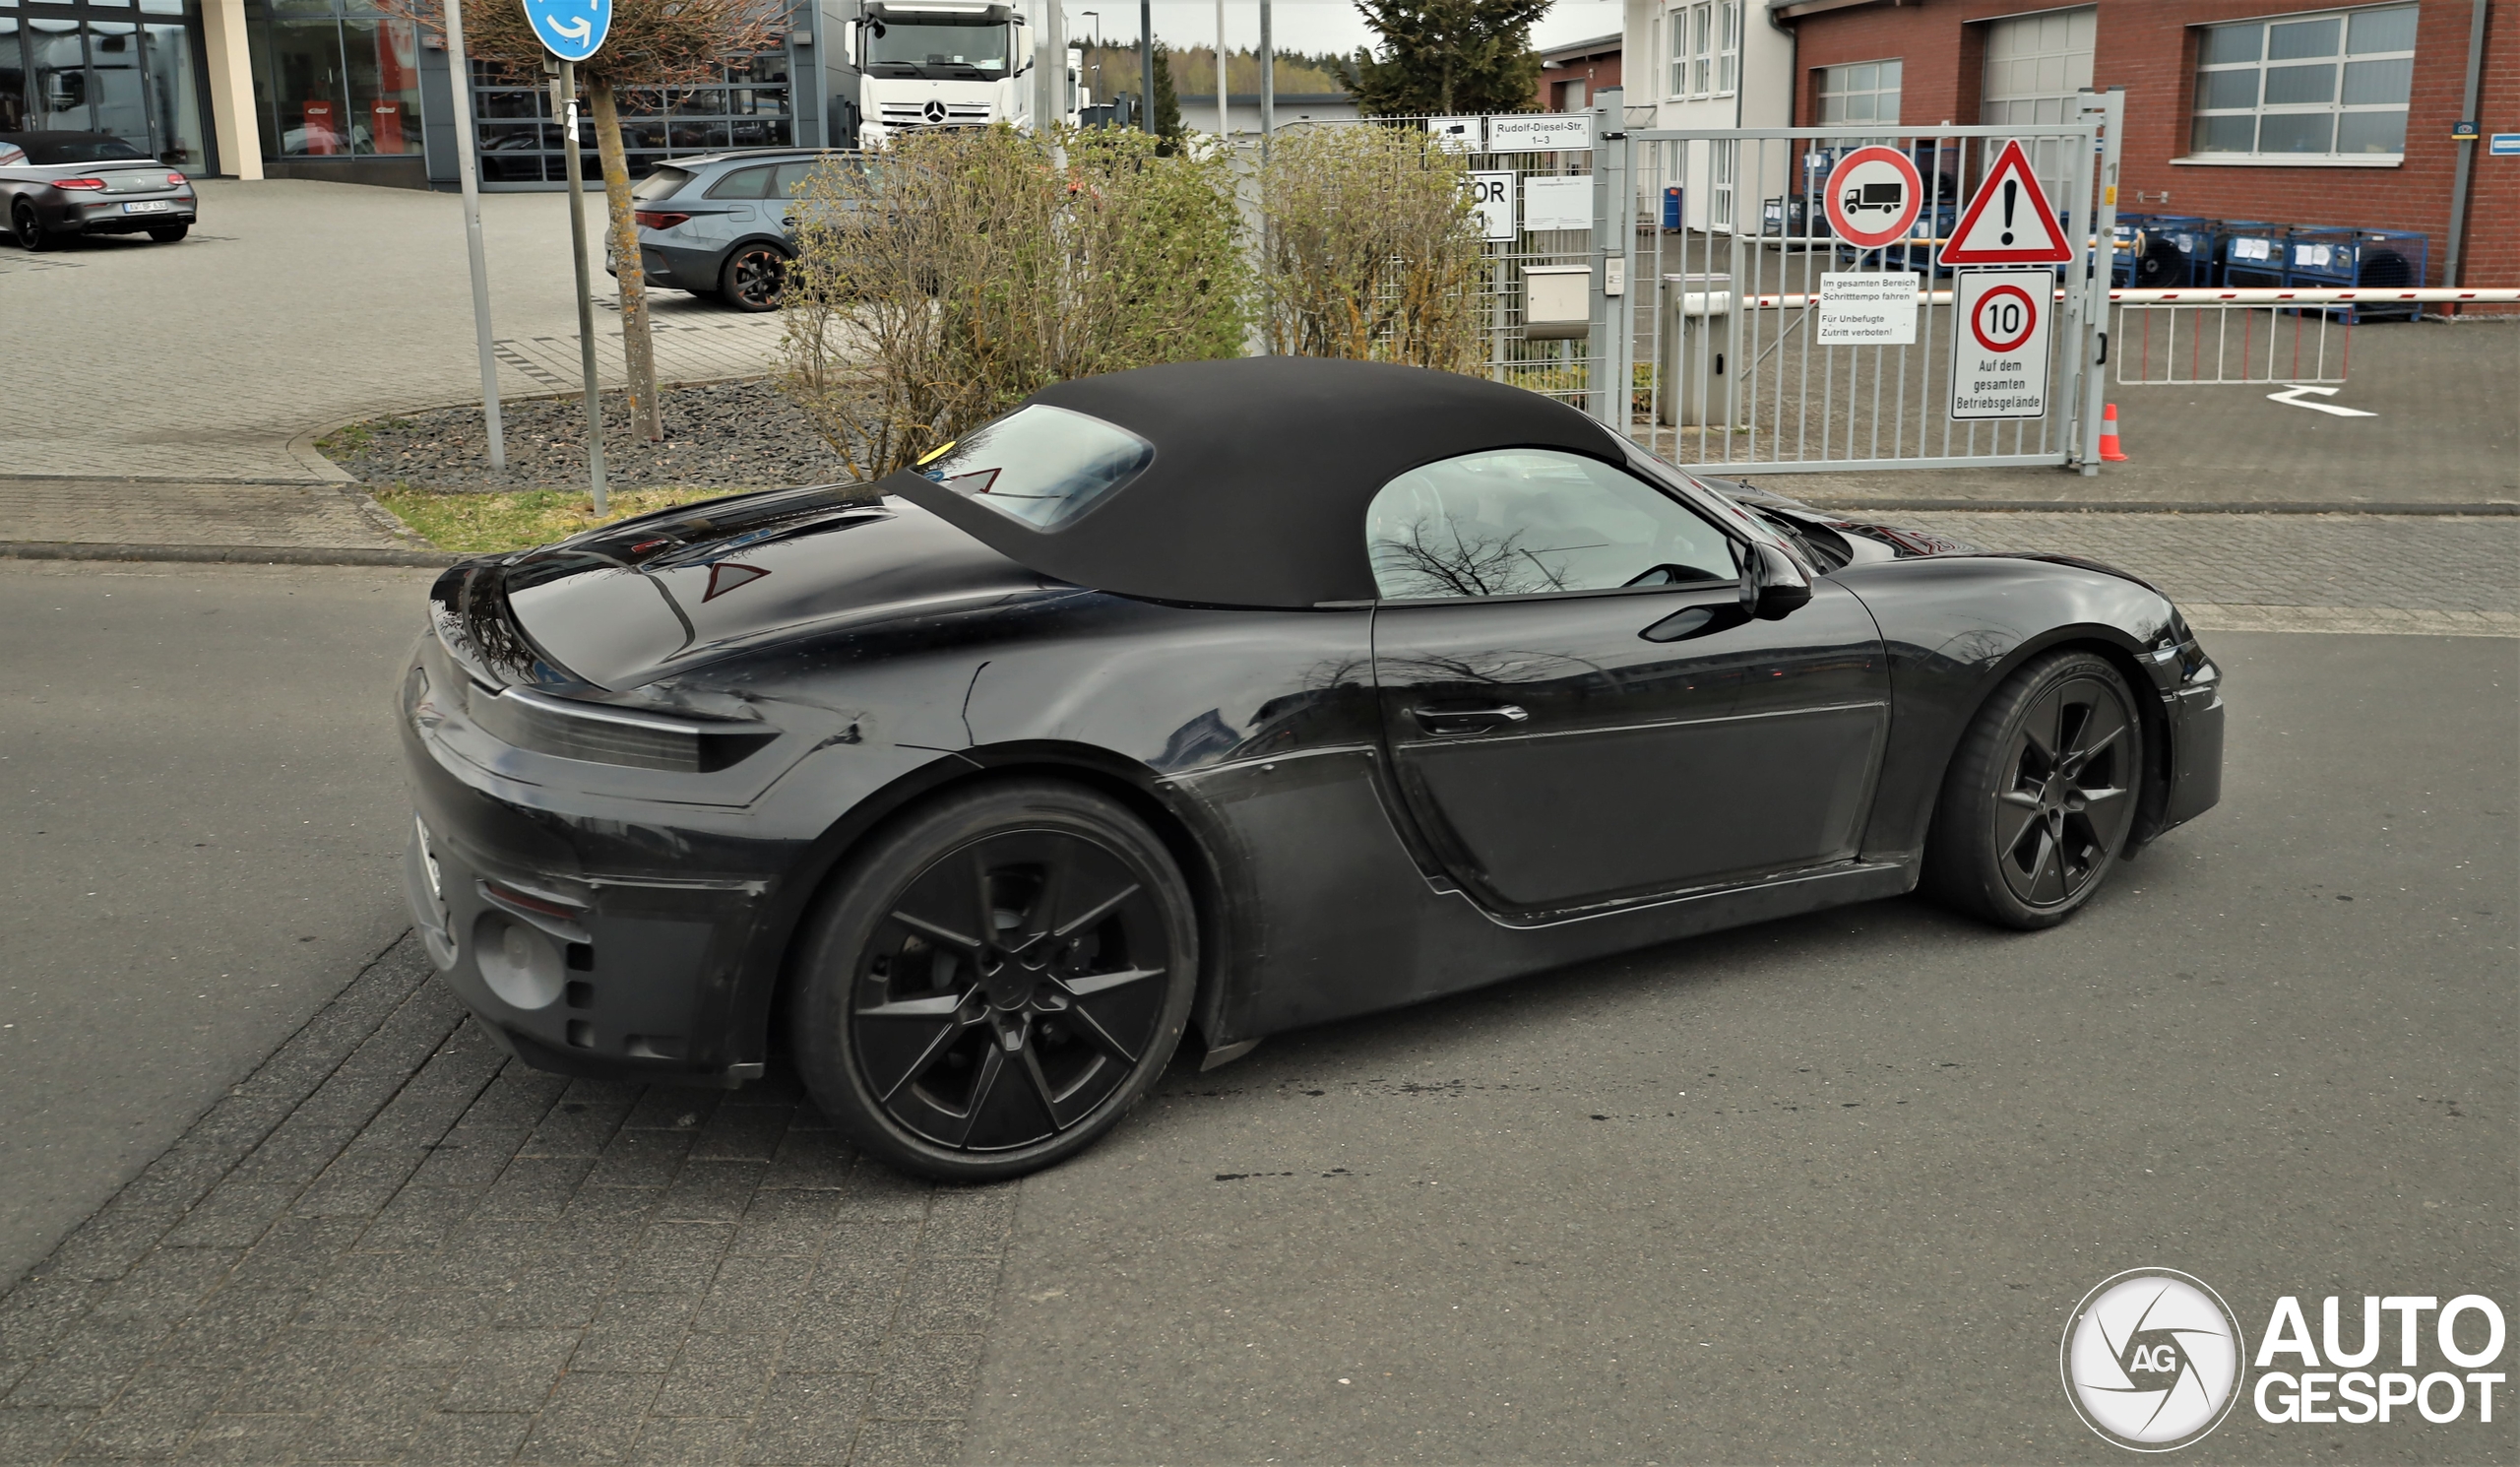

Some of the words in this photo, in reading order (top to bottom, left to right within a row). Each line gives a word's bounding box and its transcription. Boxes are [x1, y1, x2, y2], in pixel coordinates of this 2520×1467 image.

[1497, 122, 1584, 133] Rudolf-Diesel-Str.
[1837, 280, 1879, 288] gesamten
[1882, 279, 1916, 287] Bereich
[1823, 292, 1879, 301] Schritttempo
[1882, 291, 1910, 300] fahren
[1839, 315, 1884, 324] Unbefugte
[1988, 303, 2019, 334] 10
[1979, 359, 1997, 372] Auf
[1999, 359, 2022, 371] dem
[1974, 378, 2025, 394] gesamten
[1957, 395, 2040, 411] Betriebsgelände
